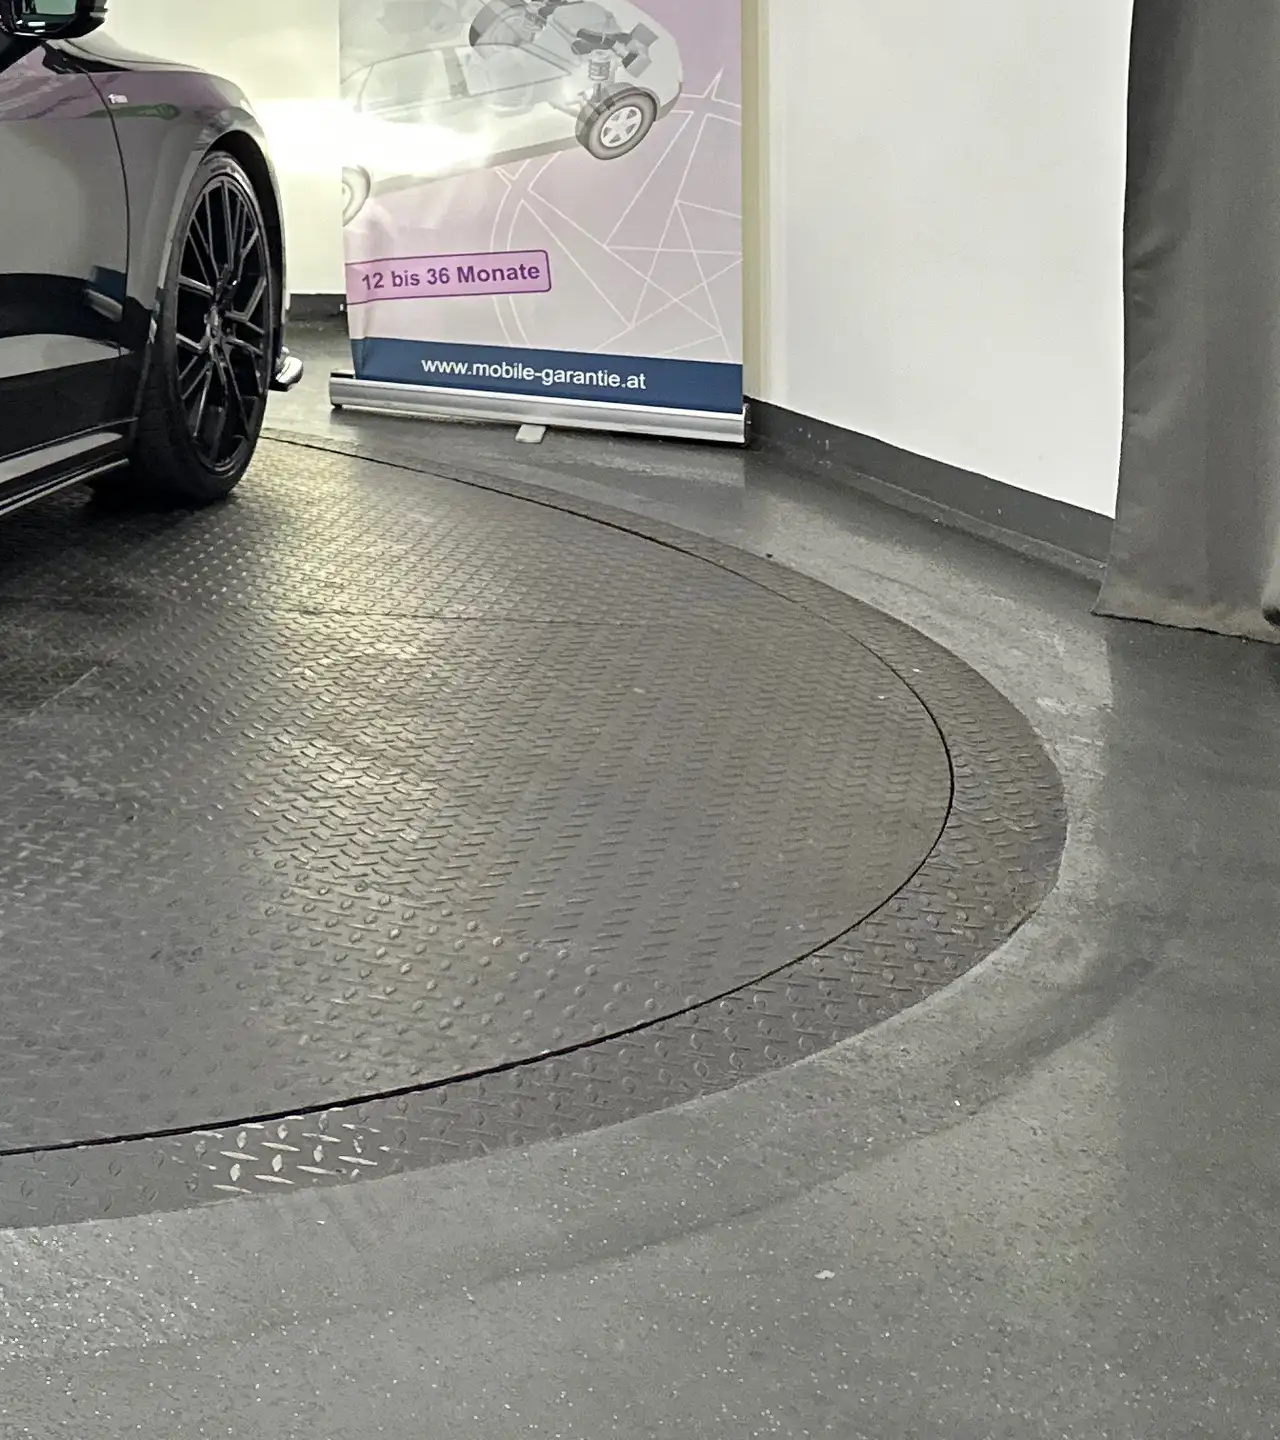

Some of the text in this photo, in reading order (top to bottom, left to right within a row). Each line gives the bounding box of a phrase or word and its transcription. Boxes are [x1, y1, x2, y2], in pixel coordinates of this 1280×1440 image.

[361, 263, 540, 291] 12 bis 36 Monate
[421, 359, 647, 389] www.mobile-garantie.at
